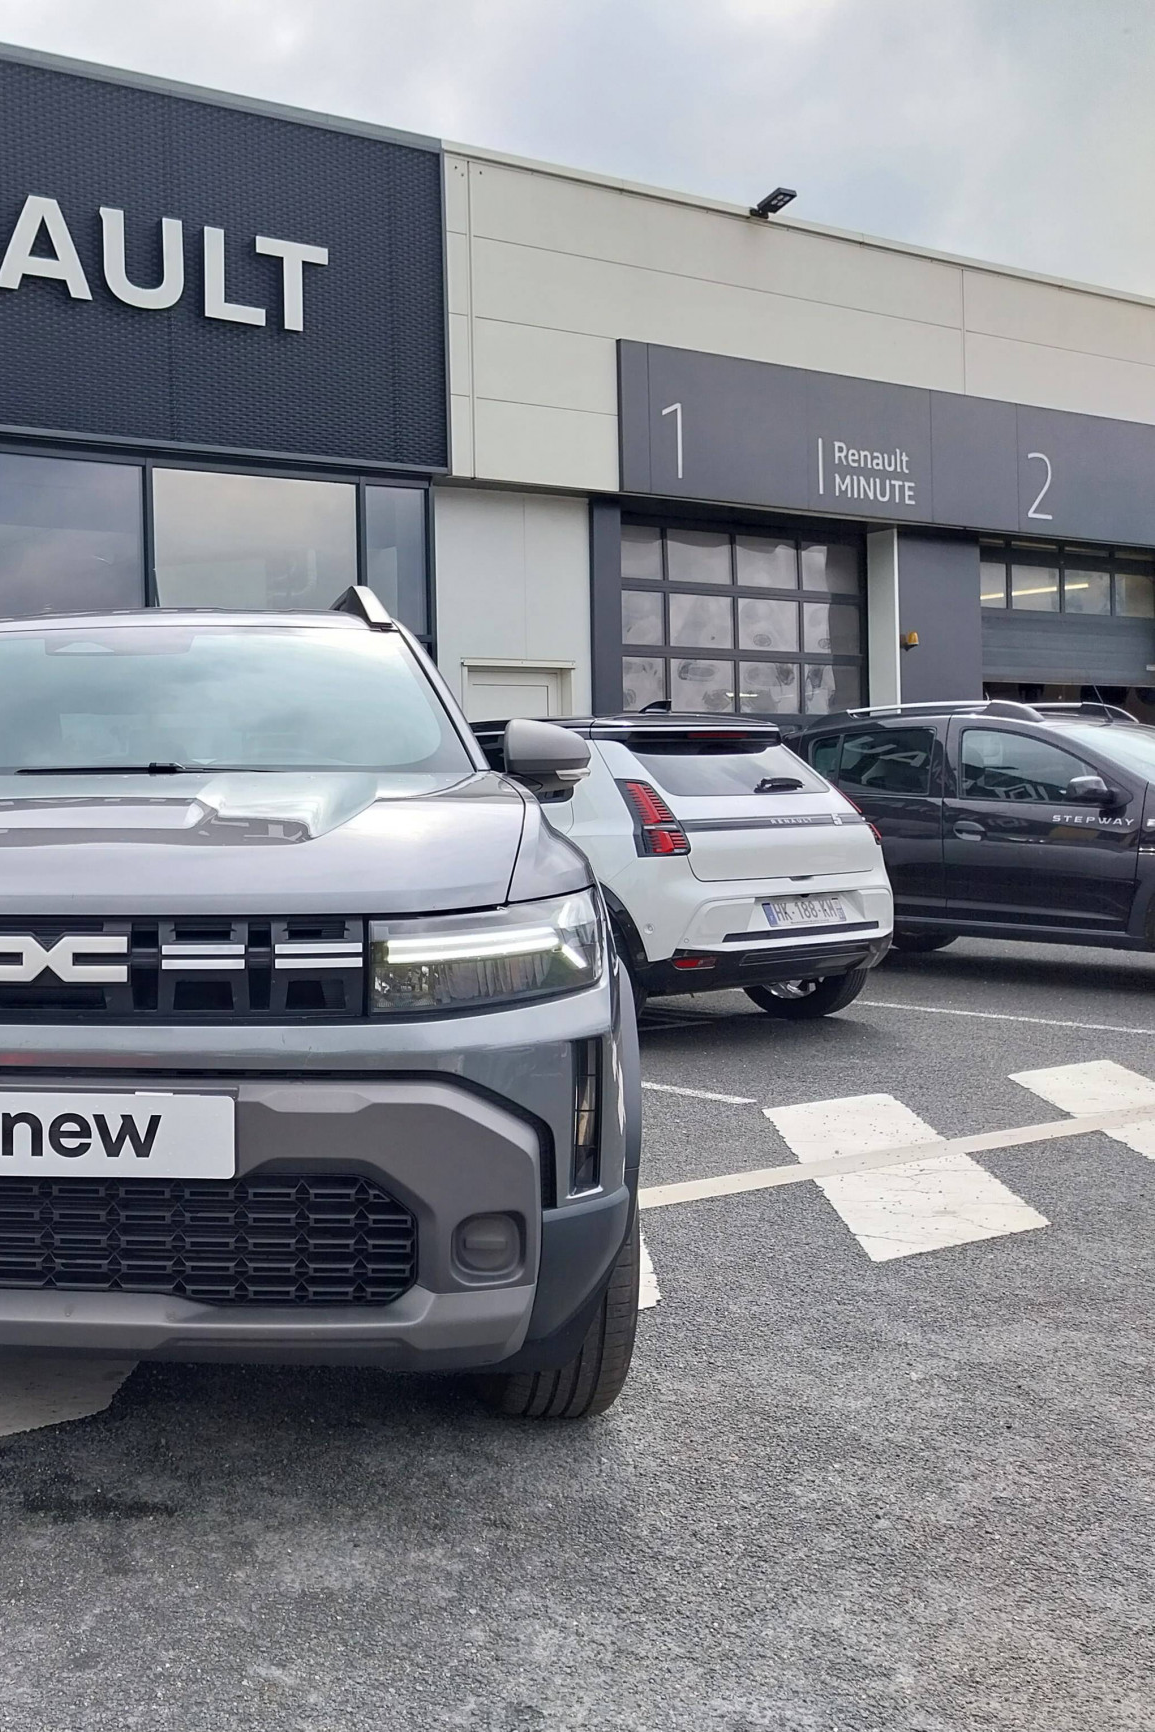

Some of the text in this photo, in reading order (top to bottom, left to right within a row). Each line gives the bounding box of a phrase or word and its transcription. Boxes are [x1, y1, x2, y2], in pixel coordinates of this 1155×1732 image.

[662, 402, 683, 480] 1
[833, 441, 910, 474] Renault
[834, 474, 916, 505] MINUTE
[1027, 452, 1053, 520] 2
[831, 813, 843, 826] 5
[1052, 814, 1135, 827] STEPWAY
